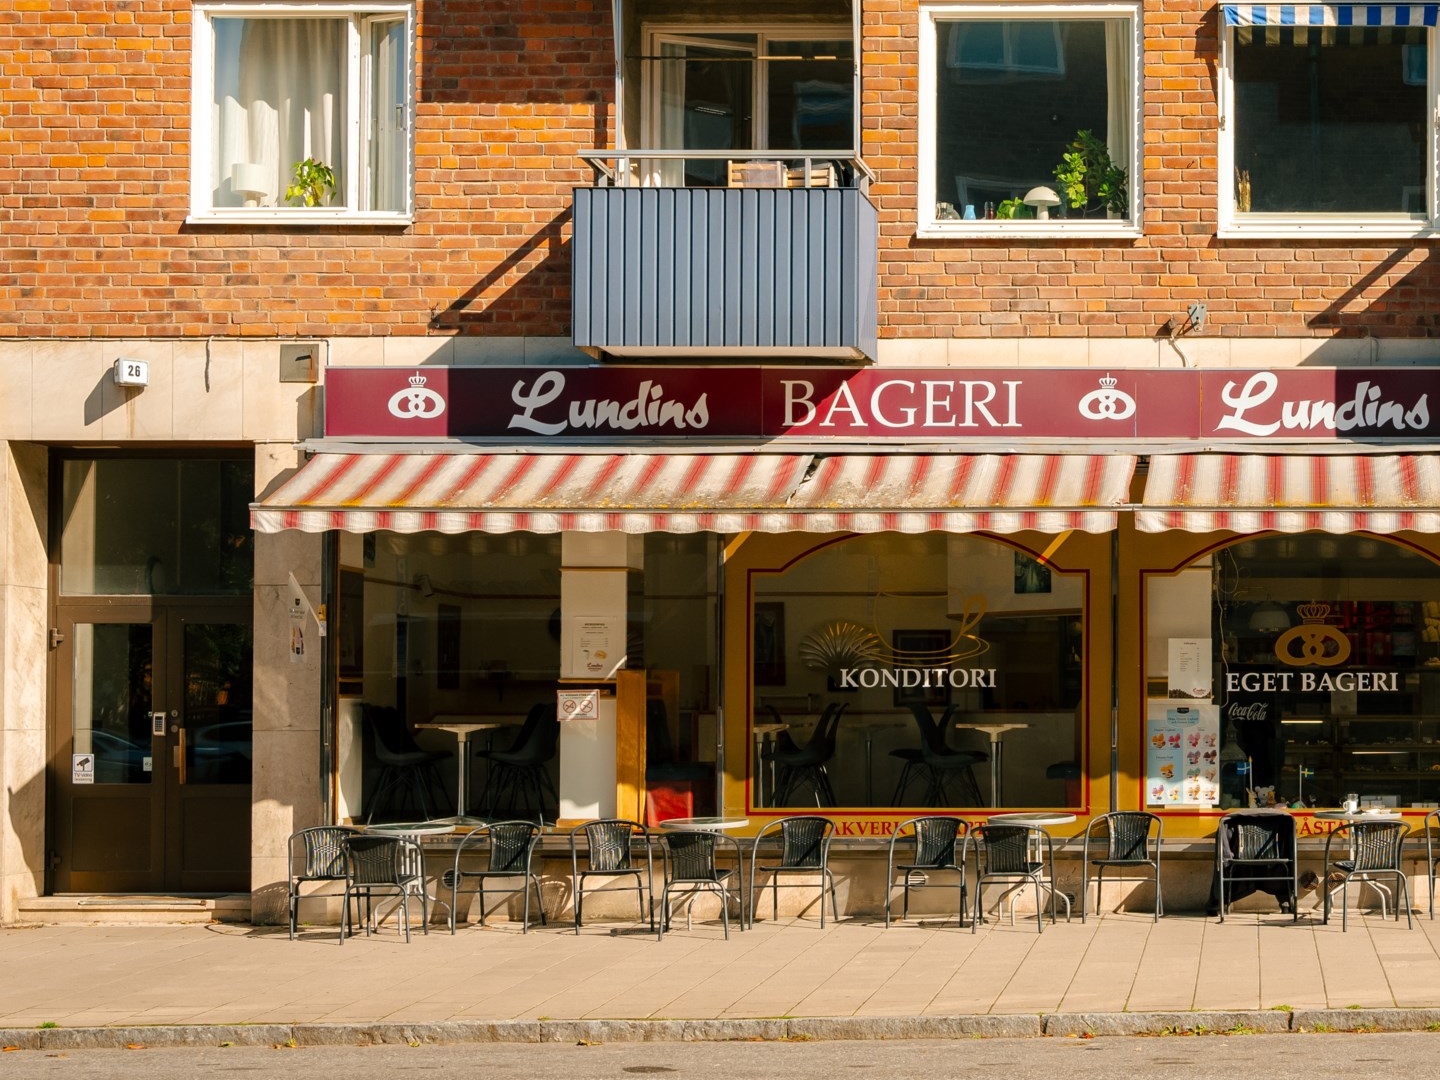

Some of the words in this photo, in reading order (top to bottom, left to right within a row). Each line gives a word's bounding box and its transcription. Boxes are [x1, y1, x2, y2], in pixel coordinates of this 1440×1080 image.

[128, 365, 141, 377] 26
[507, 370, 710, 436] Lundins
[779, 379, 1023, 428] BAGERI
[1212, 371, 1430, 437] Lundins
[839, 668, 997, 688] KONDITORI
[1226, 672, 1294, 692] EGET
[1300, 672, 1399, 692] BAGERI
